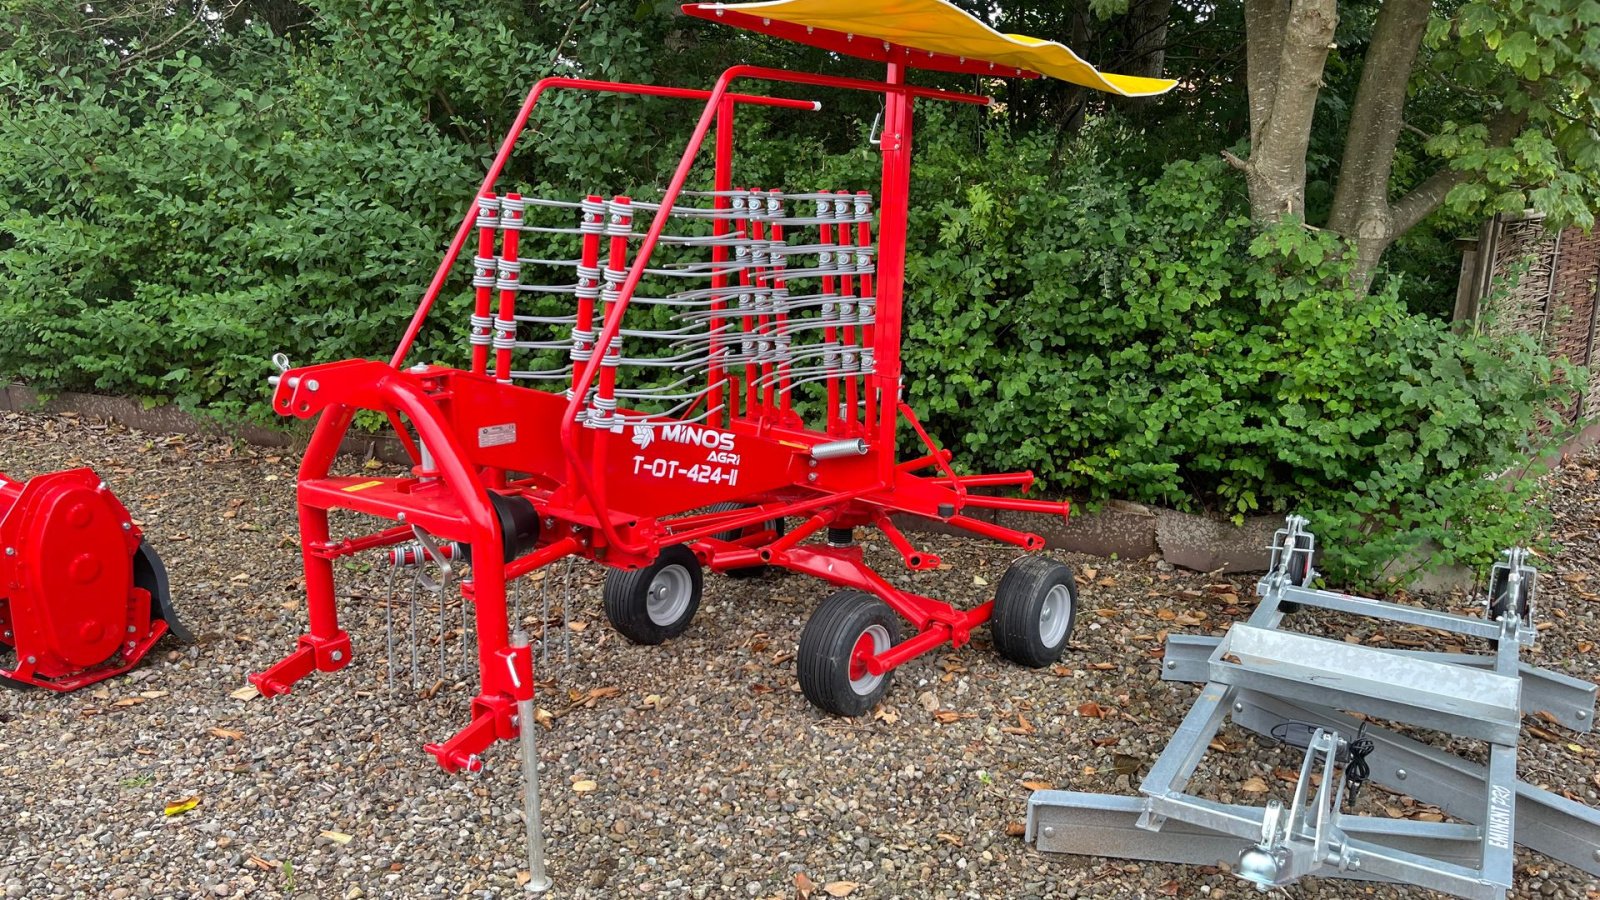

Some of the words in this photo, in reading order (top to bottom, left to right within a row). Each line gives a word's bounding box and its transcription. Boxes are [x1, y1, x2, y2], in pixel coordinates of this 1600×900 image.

[661, 424, 736, 451] MINOS
[1491, 784, 1512, 808] PRO
[1488, 804, 1511, 849] EMINENT
